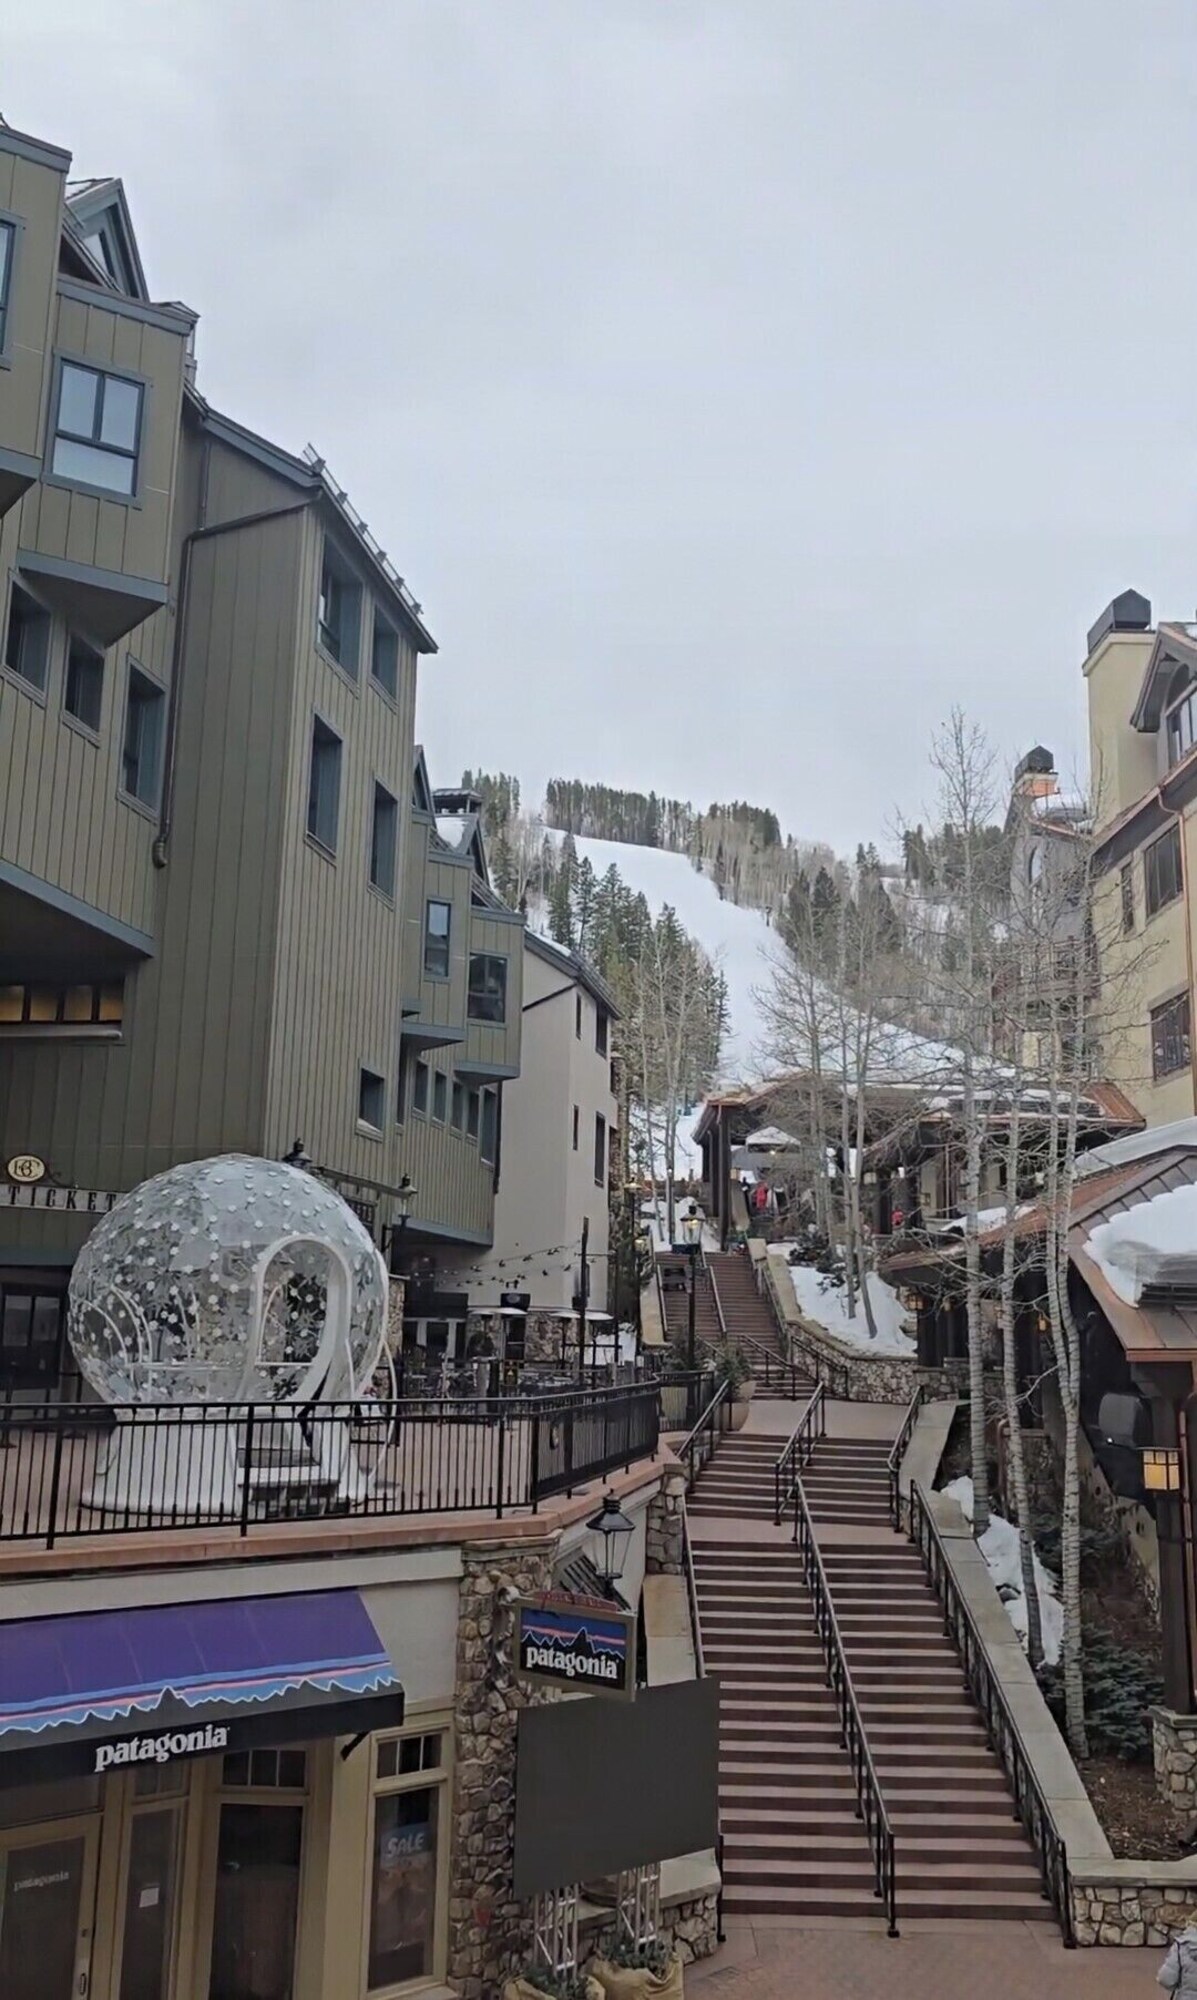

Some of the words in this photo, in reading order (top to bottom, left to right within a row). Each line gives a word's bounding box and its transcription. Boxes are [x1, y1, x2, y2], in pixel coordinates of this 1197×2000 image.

[526, 1646, 618, 1679] patagonia
[94, 1724, 229, 1772] patagonia
[386, 1832, 425, 1857] SALE
